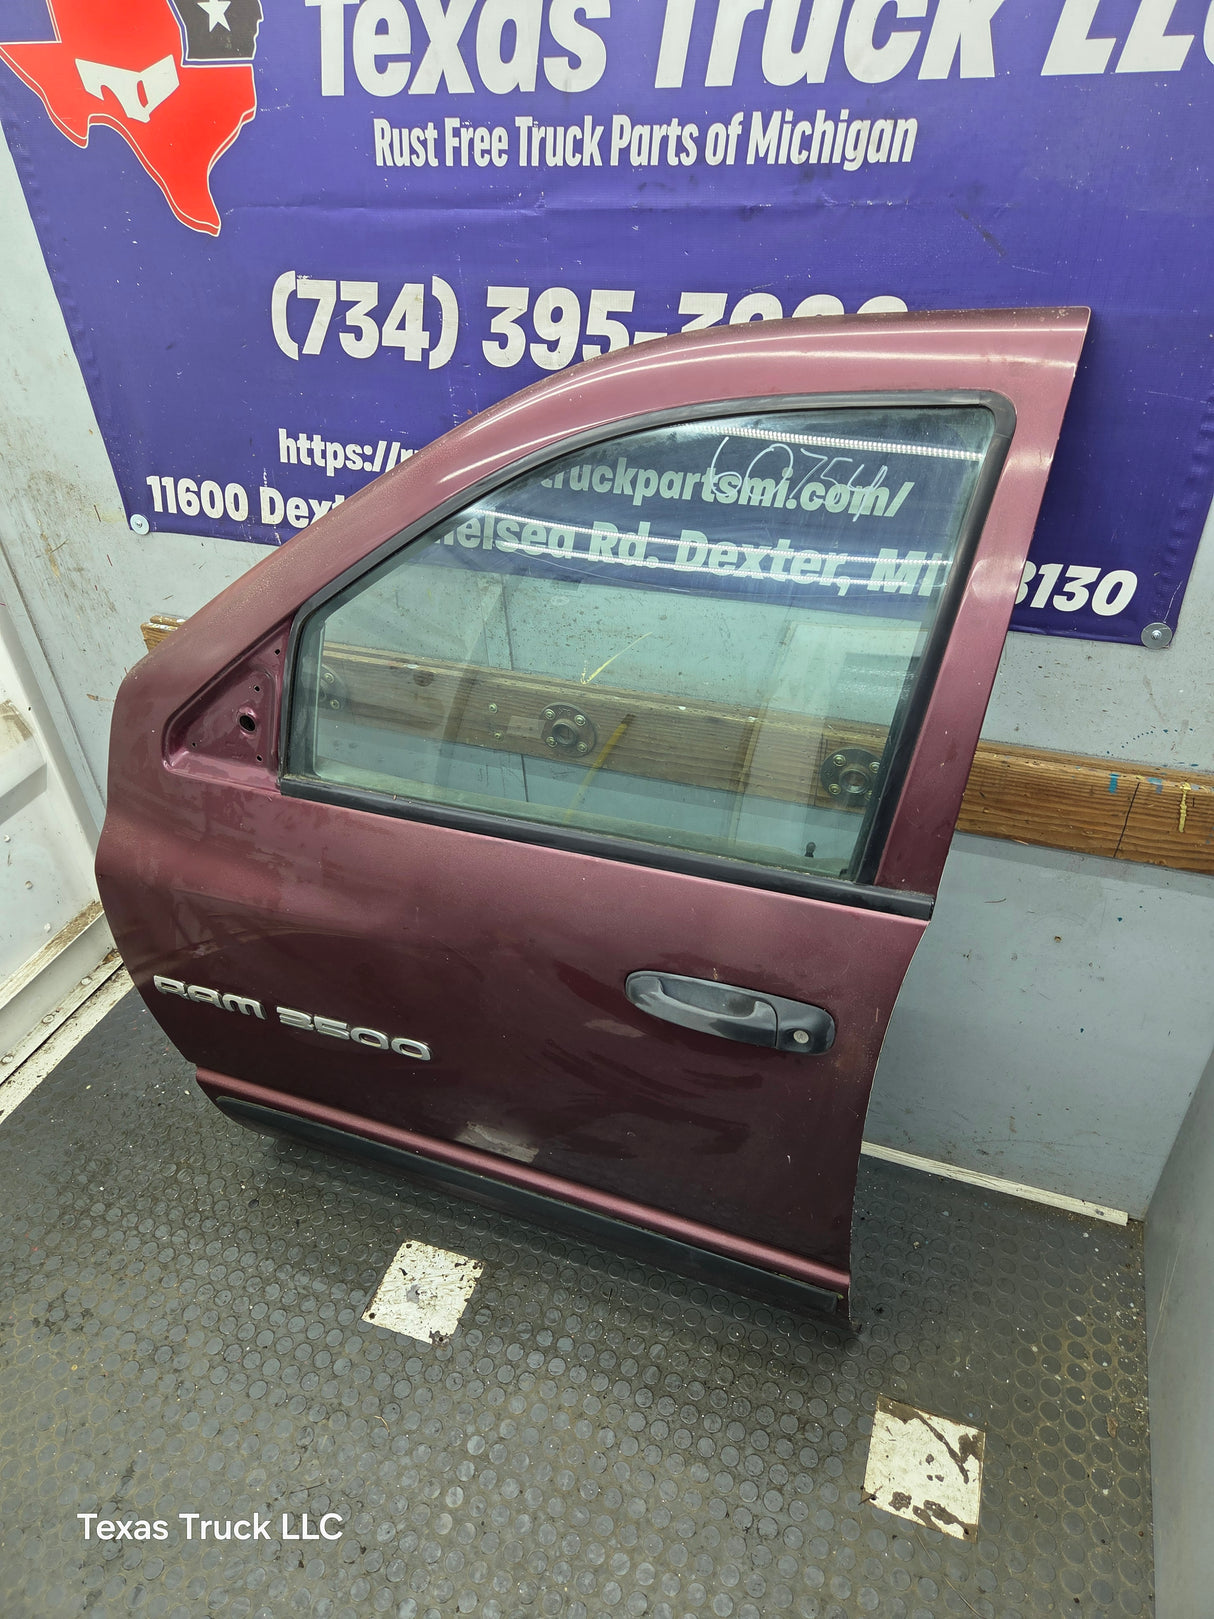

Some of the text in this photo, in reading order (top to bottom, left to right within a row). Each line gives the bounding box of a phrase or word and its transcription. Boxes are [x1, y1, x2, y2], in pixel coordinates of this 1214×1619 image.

[305, 0, 1214, 97] Texas Truck LL
[373, 108, 918, 172] Rust Free Truck Parts of Michigan
[271, 271, 909, 371] (734) 395-3
[278, 428, 916, 518] https://r ruckpartsmi.com/
[146, 475, 249, 523] 11600
[587, 520, 659, 569] Rd.
[673, 529, 861, 597] Dexter,
[866, 547, 943, 598] MI
[152, 974, 432, 1062] RAM 3500
